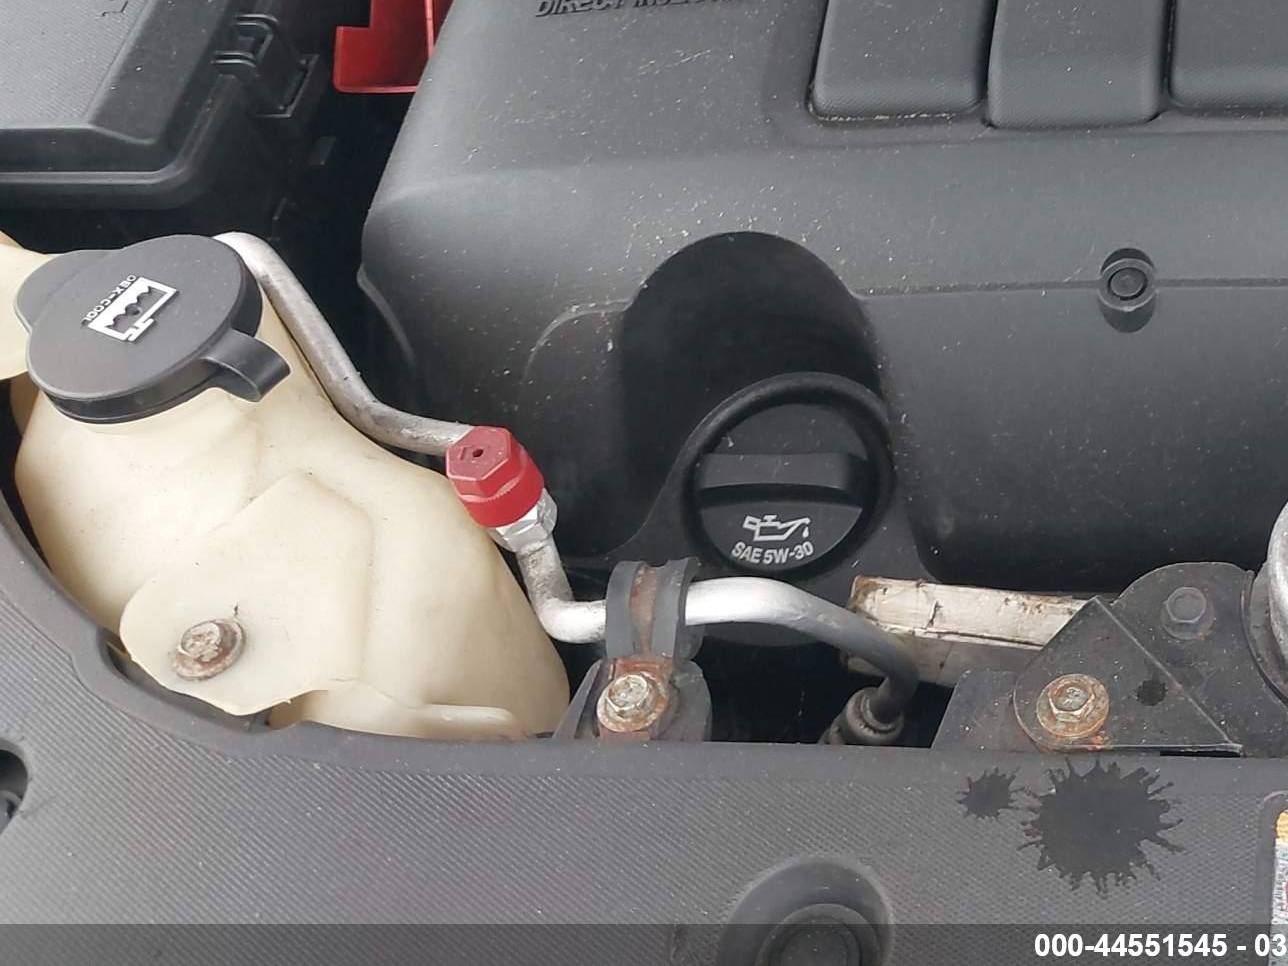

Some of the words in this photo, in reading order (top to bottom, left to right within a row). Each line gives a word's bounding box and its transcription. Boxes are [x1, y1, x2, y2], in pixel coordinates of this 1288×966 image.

[81, 274, 137, 323] DEX-COOL
[731, 541, 763, 564] SAE
[762, 541, 814, 565] 5W-30
